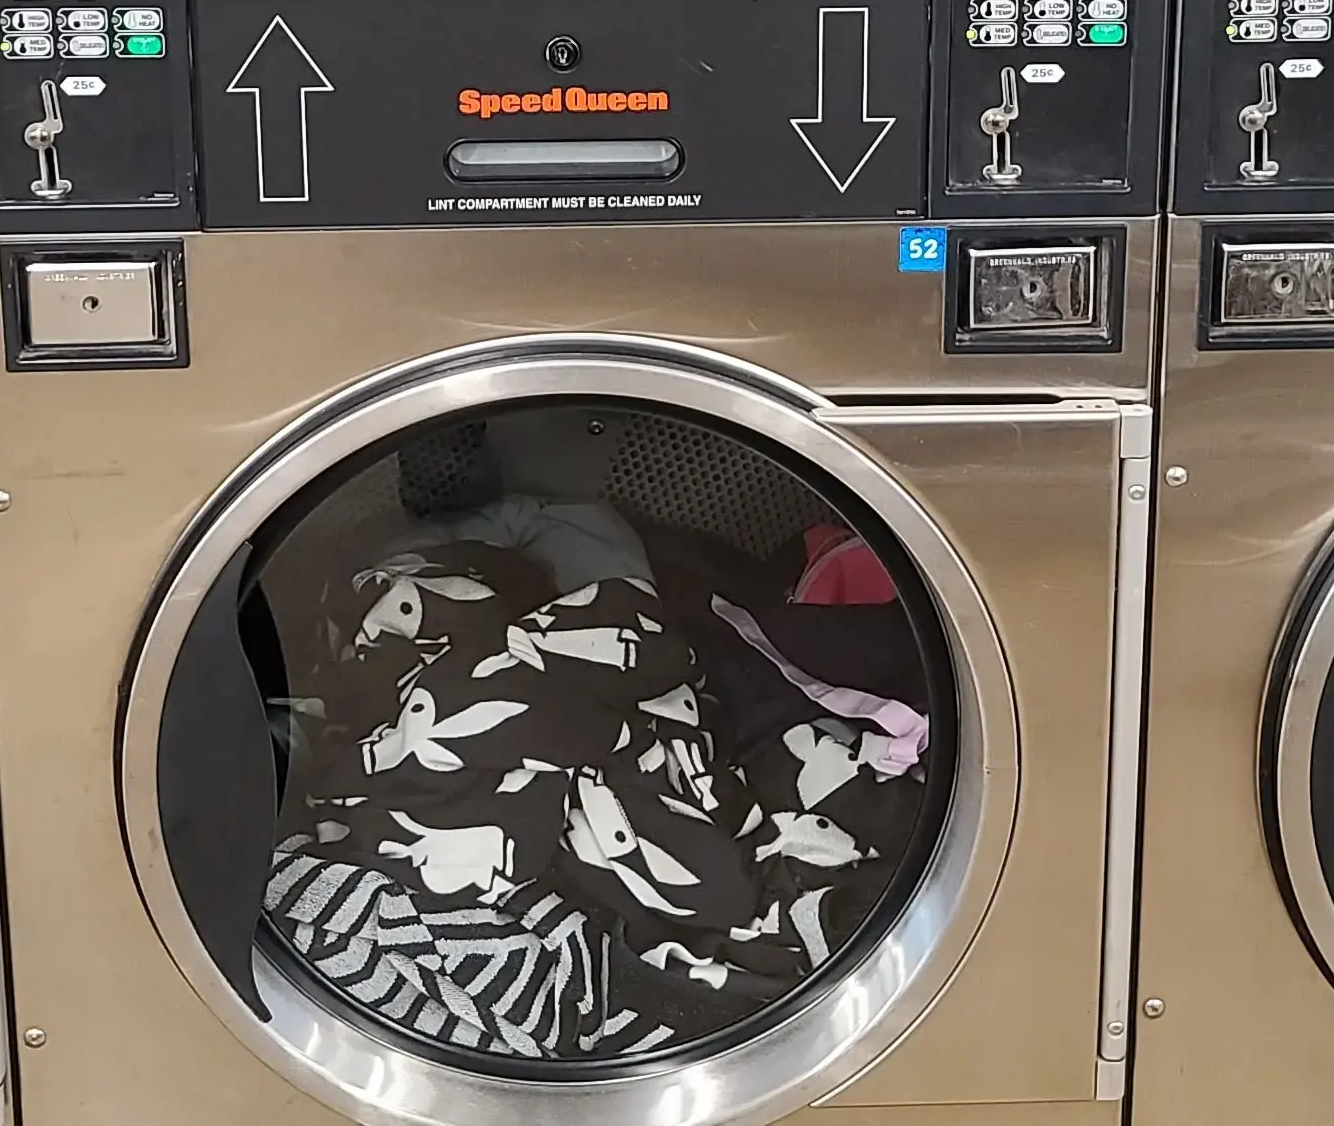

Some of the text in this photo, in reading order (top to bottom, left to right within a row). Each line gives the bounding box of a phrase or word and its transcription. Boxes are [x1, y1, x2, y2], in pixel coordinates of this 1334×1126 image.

[459, 87, 669, 119] Speed Queen
[427, 194, 702, 212] LINT COMPARTMENT MUST BE CLEANED DAILY
[909, 238, 938, 259] 52
